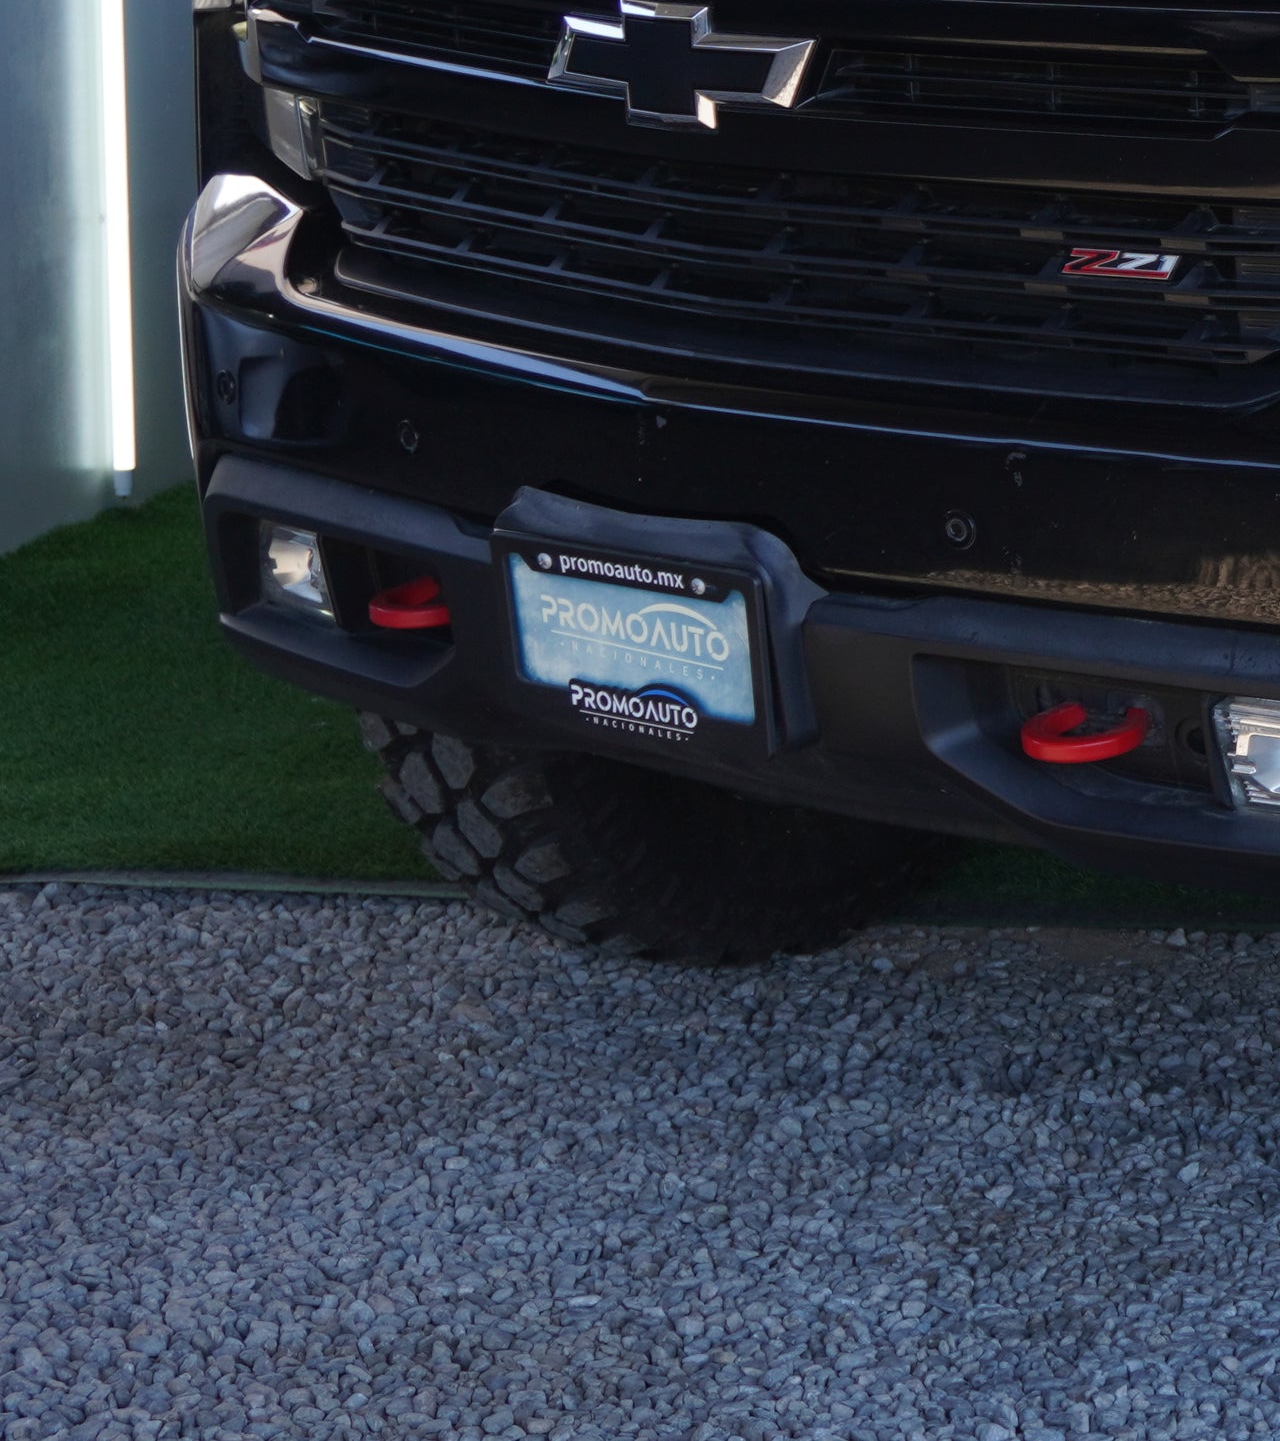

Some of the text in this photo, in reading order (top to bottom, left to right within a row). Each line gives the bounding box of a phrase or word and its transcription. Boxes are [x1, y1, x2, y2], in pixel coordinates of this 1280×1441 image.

[1062, 247, 1179, 280] Z71
[559, 554, 685, 589] promoauto.mx
[539, 594, 729, 662] PROMOAUTO
[570, 640, 704, 680] NACIONALES
[570, 684, 698, 729] PROMOAUTO
[592, 716, 682, 741] NACIONALES
